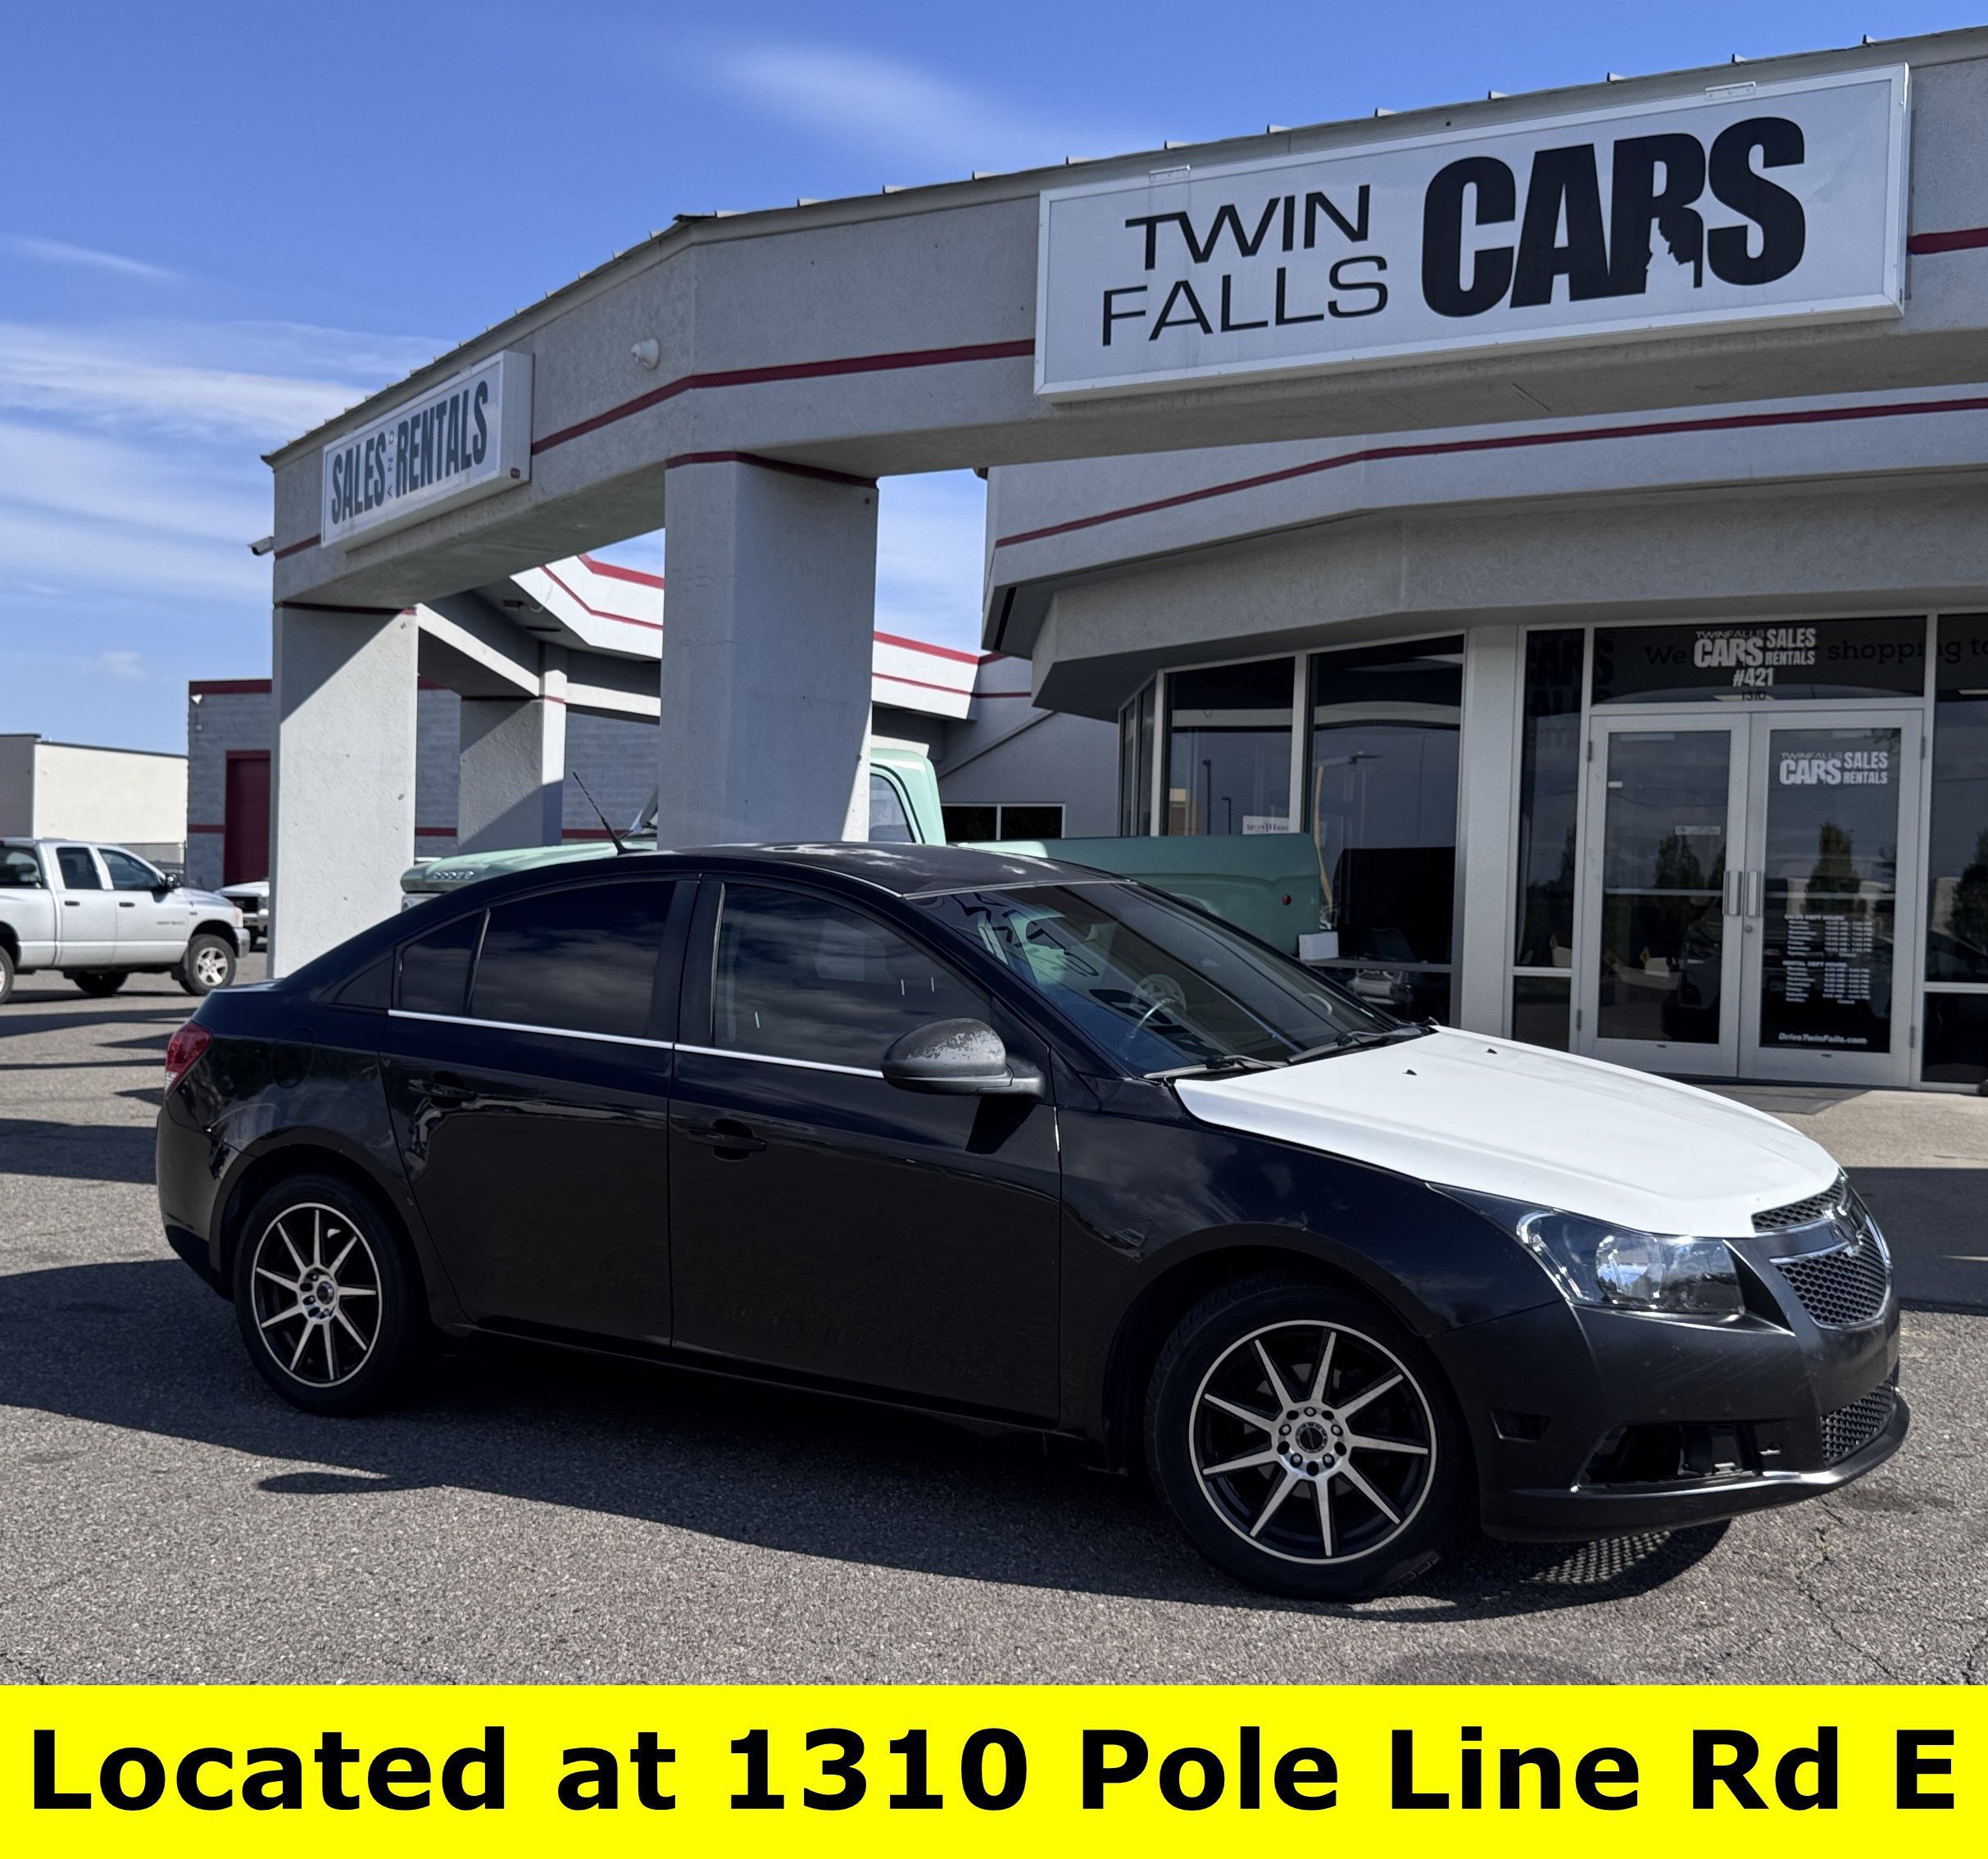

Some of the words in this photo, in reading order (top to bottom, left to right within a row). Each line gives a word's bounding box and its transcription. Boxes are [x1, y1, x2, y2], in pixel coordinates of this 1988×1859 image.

[1125, 184, 1371, 271] TWIN
[1422, 116, 1805, 318] CARS
[1102, 255, 1388, 347] FALLS
[396, 380, 489, 498] RENTALS
[331, 431, 387, 525] SALES
[1765, 627, 1816, 648] SALES
[1645, 644, 1686, 666] We
[1827, 638, 1962, 664] shoppig
[1694, 638, 1764, 668] CARS
[1765, 650, 1816, 666] RENTALS
[1732, 667, 1774, 688] #421
[1779, 759, 1842, 785] CARS
[1843, 752, 1888, 769] SALES
[1843, 770, 1888, 784] RENTALS
